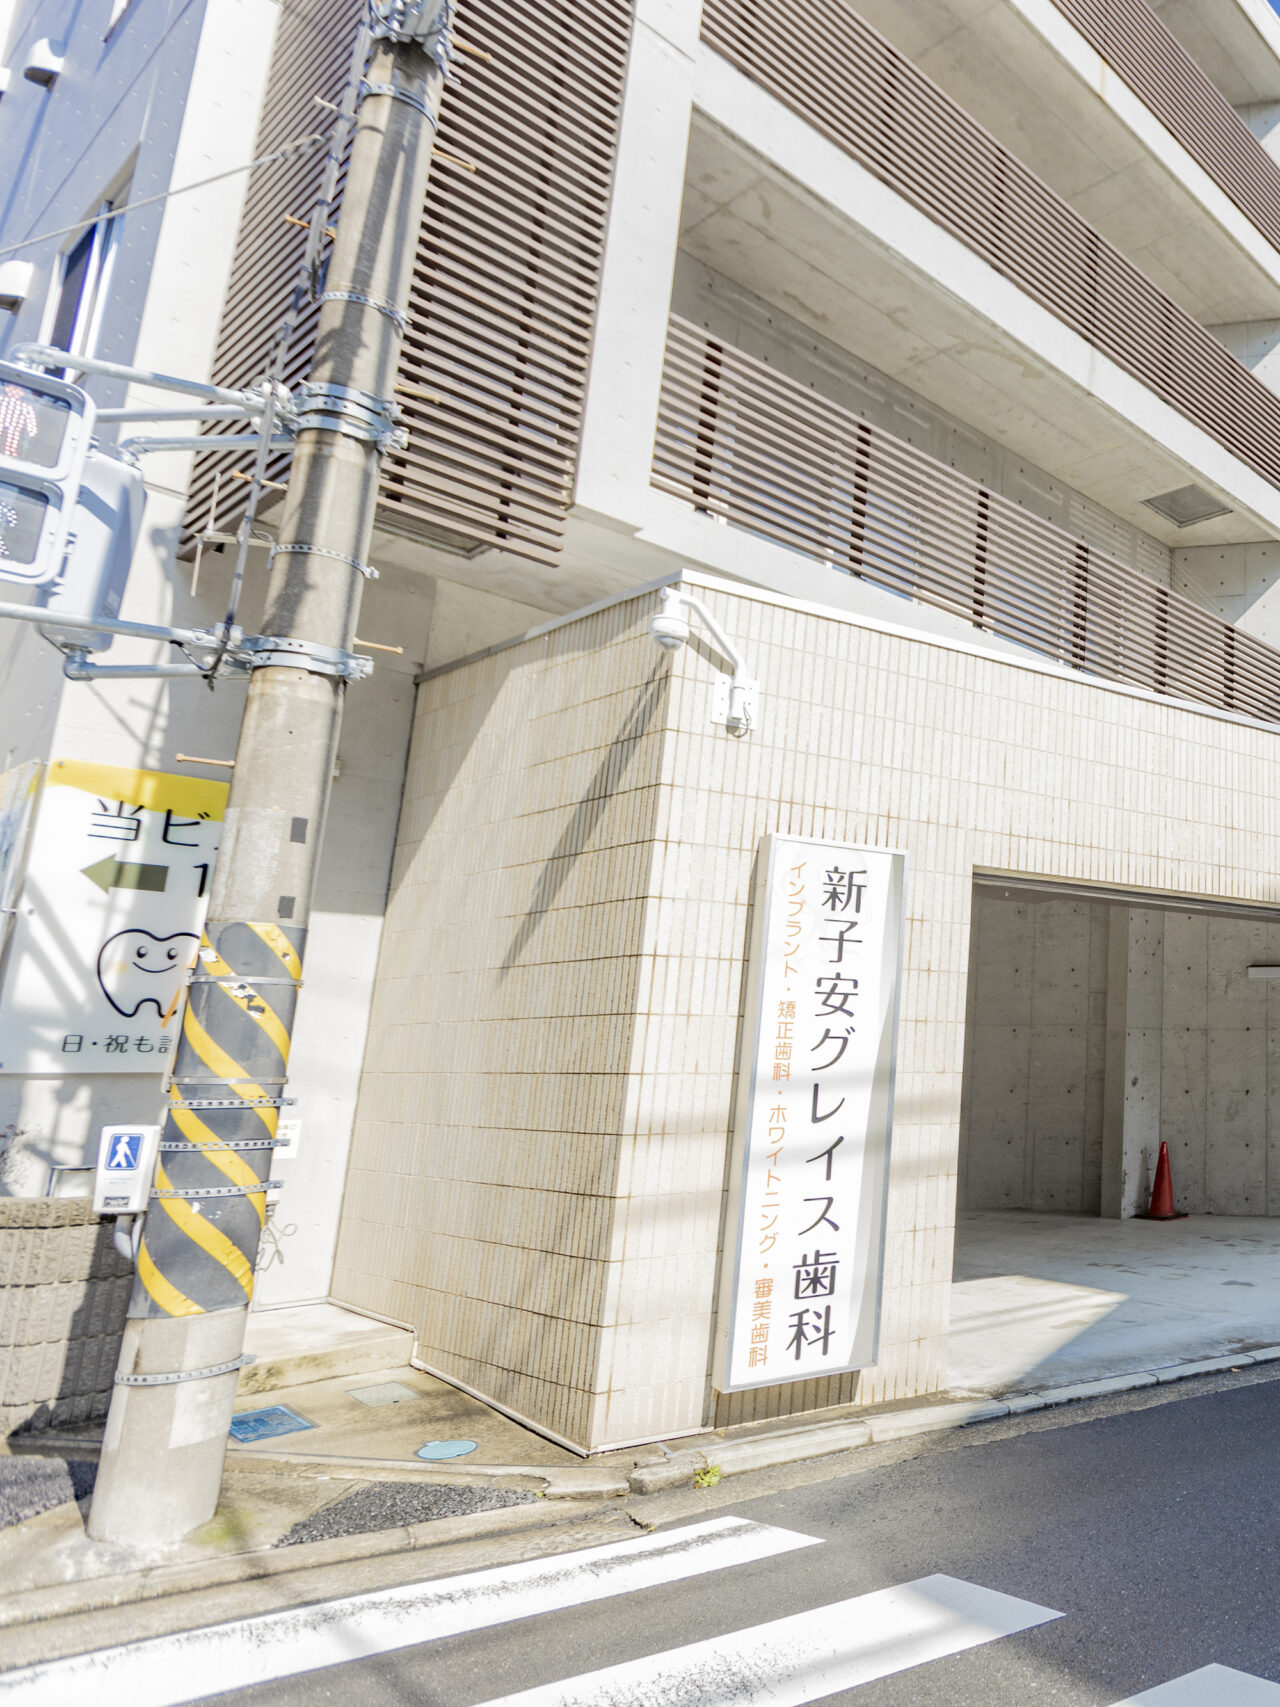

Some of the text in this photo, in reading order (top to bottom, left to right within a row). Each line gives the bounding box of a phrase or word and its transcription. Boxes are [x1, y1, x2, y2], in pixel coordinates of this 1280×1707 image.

[87, 799, 218, 850] 当ビ
[786, 865, 868, 1362] 新子安グレイス歯科
